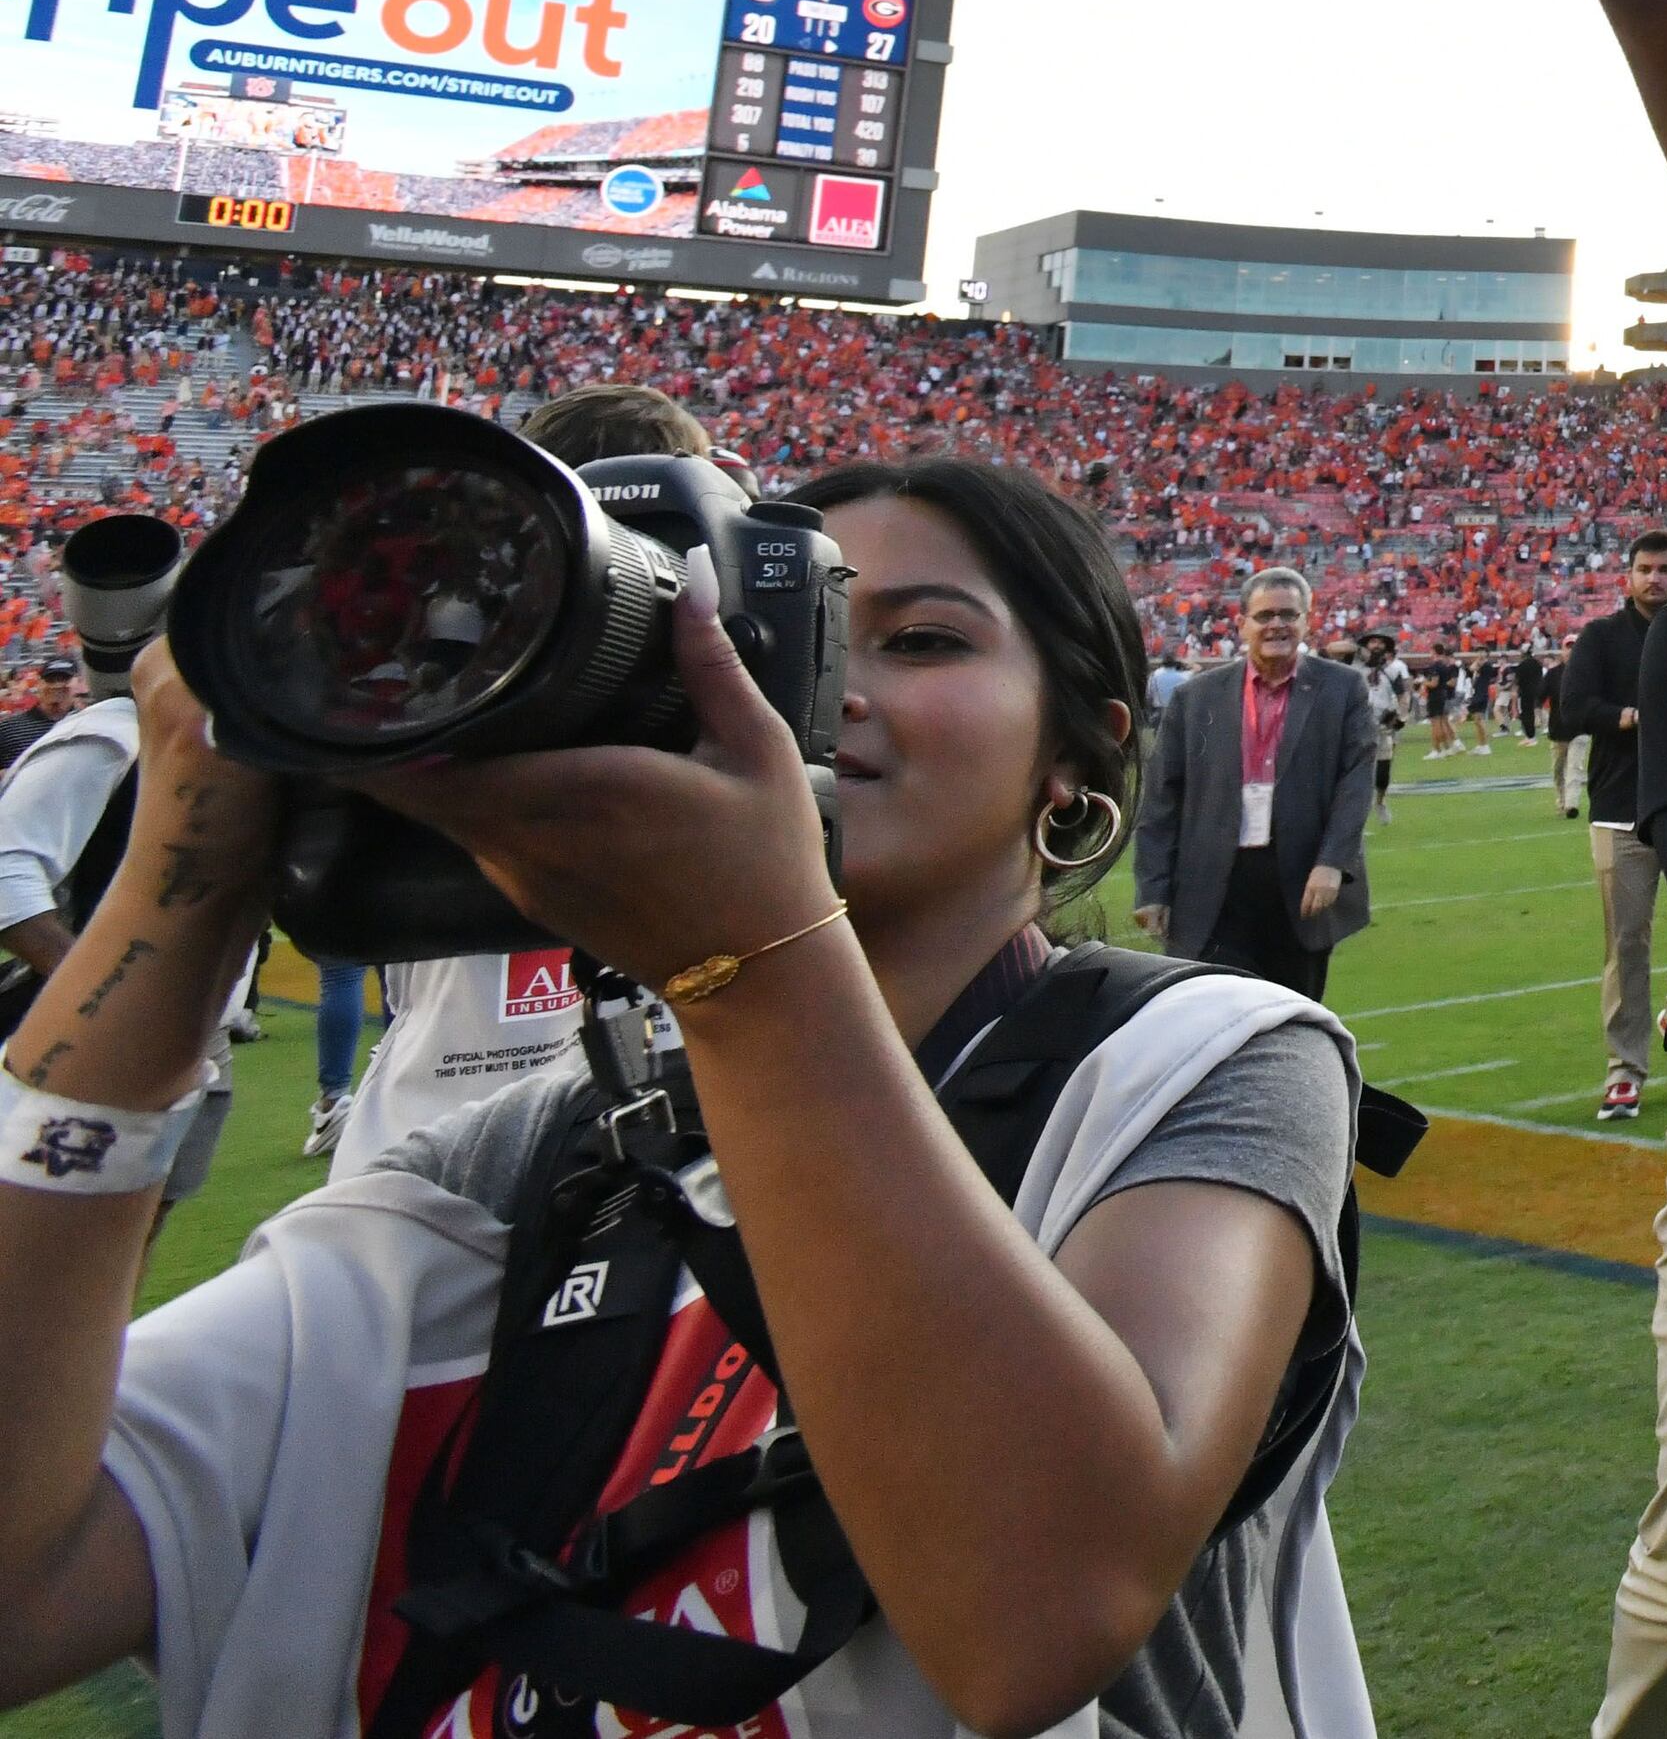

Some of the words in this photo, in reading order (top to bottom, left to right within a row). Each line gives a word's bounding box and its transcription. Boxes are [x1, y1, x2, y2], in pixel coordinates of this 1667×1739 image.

[741, 12, 777, 45] 20
[865, 31, 897, 61] 27
[206, 48, 561, 106] AUBURNTIGERS.COM/STRIPEOUT
[208, 195, 291, 231] 0:00
[705, 199, 789, 225] Alabama
[367, 223, 491, 250] YellaWood
[716, 218, 775, 240] Power
[823, 215, 874, 238] ALFA
[781, 267, 860, 286] REGIONS
[757, 542, 797, 557] EOS
[761, 563, 789, 579] 5D
[755, 579, 782, 589] Mark
[435, 1065, 457, 1079] THIS
[458, 1062, 484, 1076] VEST
[485, 1060, 509, 1073] MUST
[511, 1057, 527, 1070] BE
[442, 1050, 486, 1065] OFFICIAL
